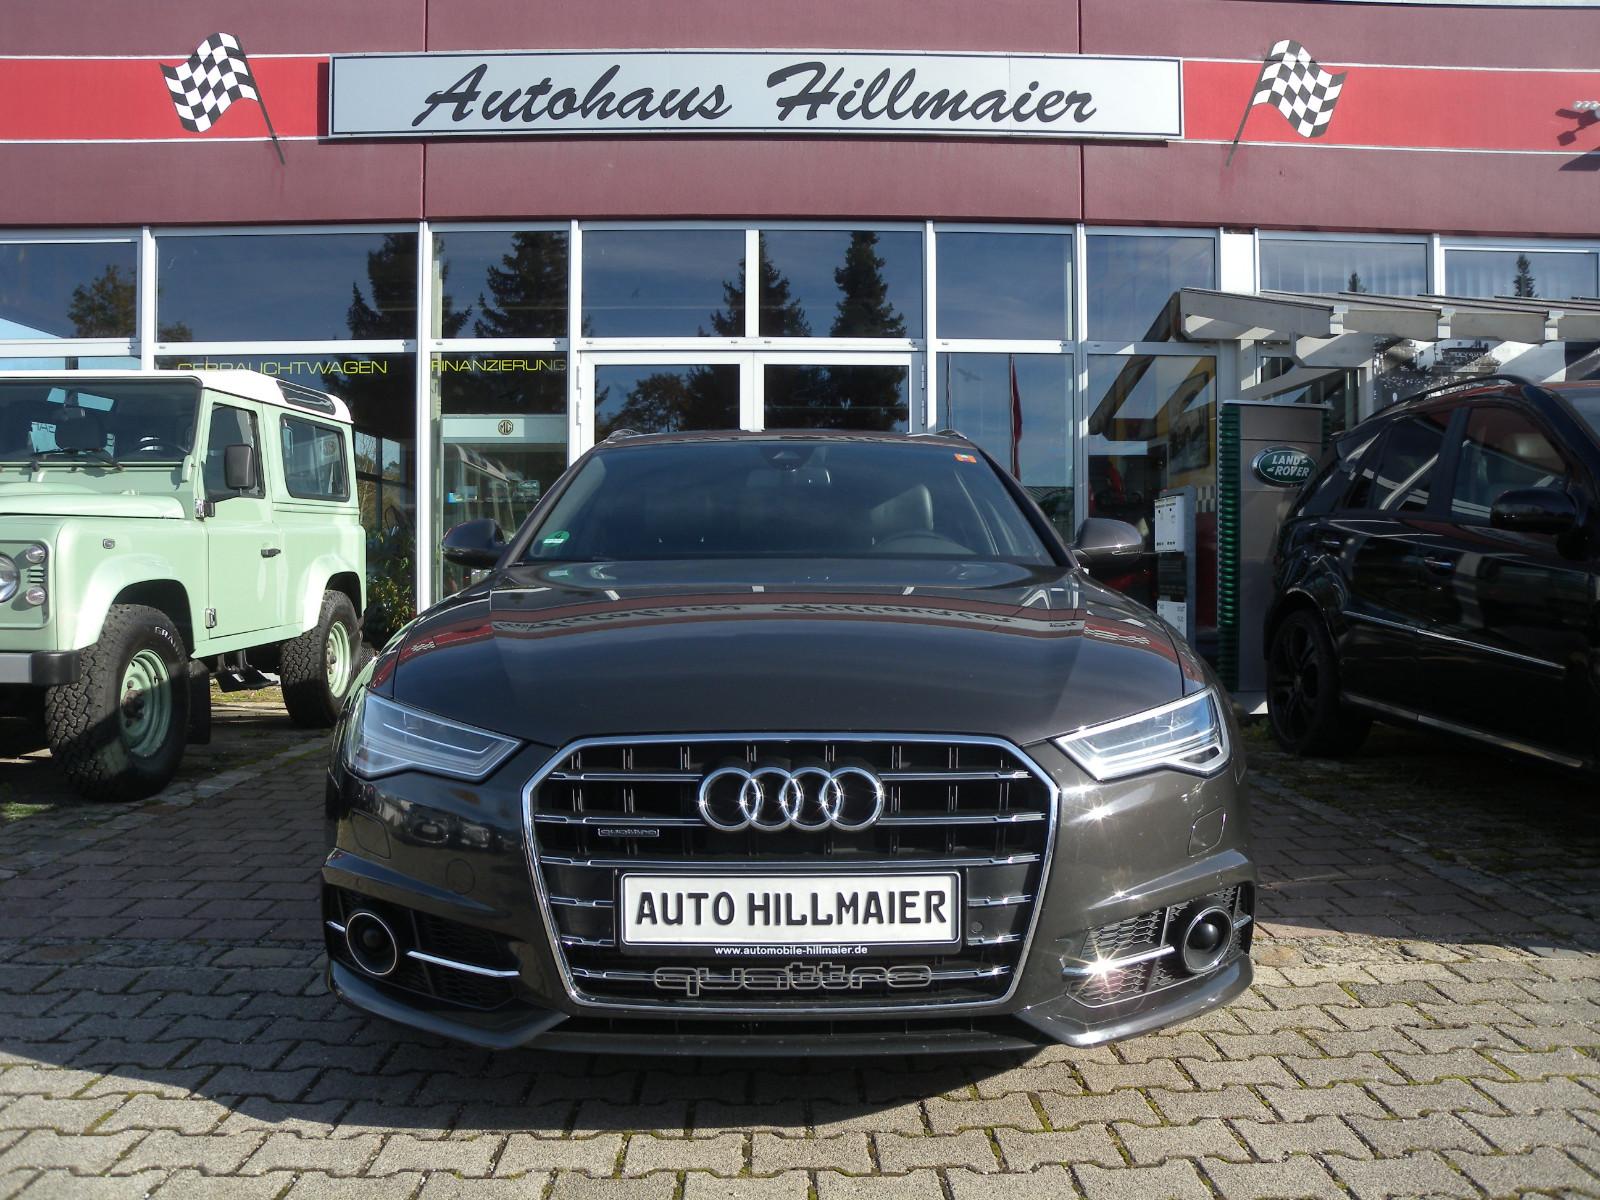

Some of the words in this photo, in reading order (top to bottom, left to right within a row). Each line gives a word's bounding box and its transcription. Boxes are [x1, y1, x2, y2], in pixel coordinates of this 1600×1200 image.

[412, 63, 733, 127] Autohaus
[766, 61, 1097, 123] Hillmaier
[431, 359, 567, 372] FINANZIERUNG
[499, 420, 513, 434] MG
[1272, 455, 1301, 465] LAND
[1274, 466, 1310, 477] ROVER
[635, 891, 736, 926] AUTO
[748, 890, 948, 926] HILLMAIER
[714, 945, 868, 955] www.automobile-hillmaier.de
[653, 962, 933, 997] quattro
